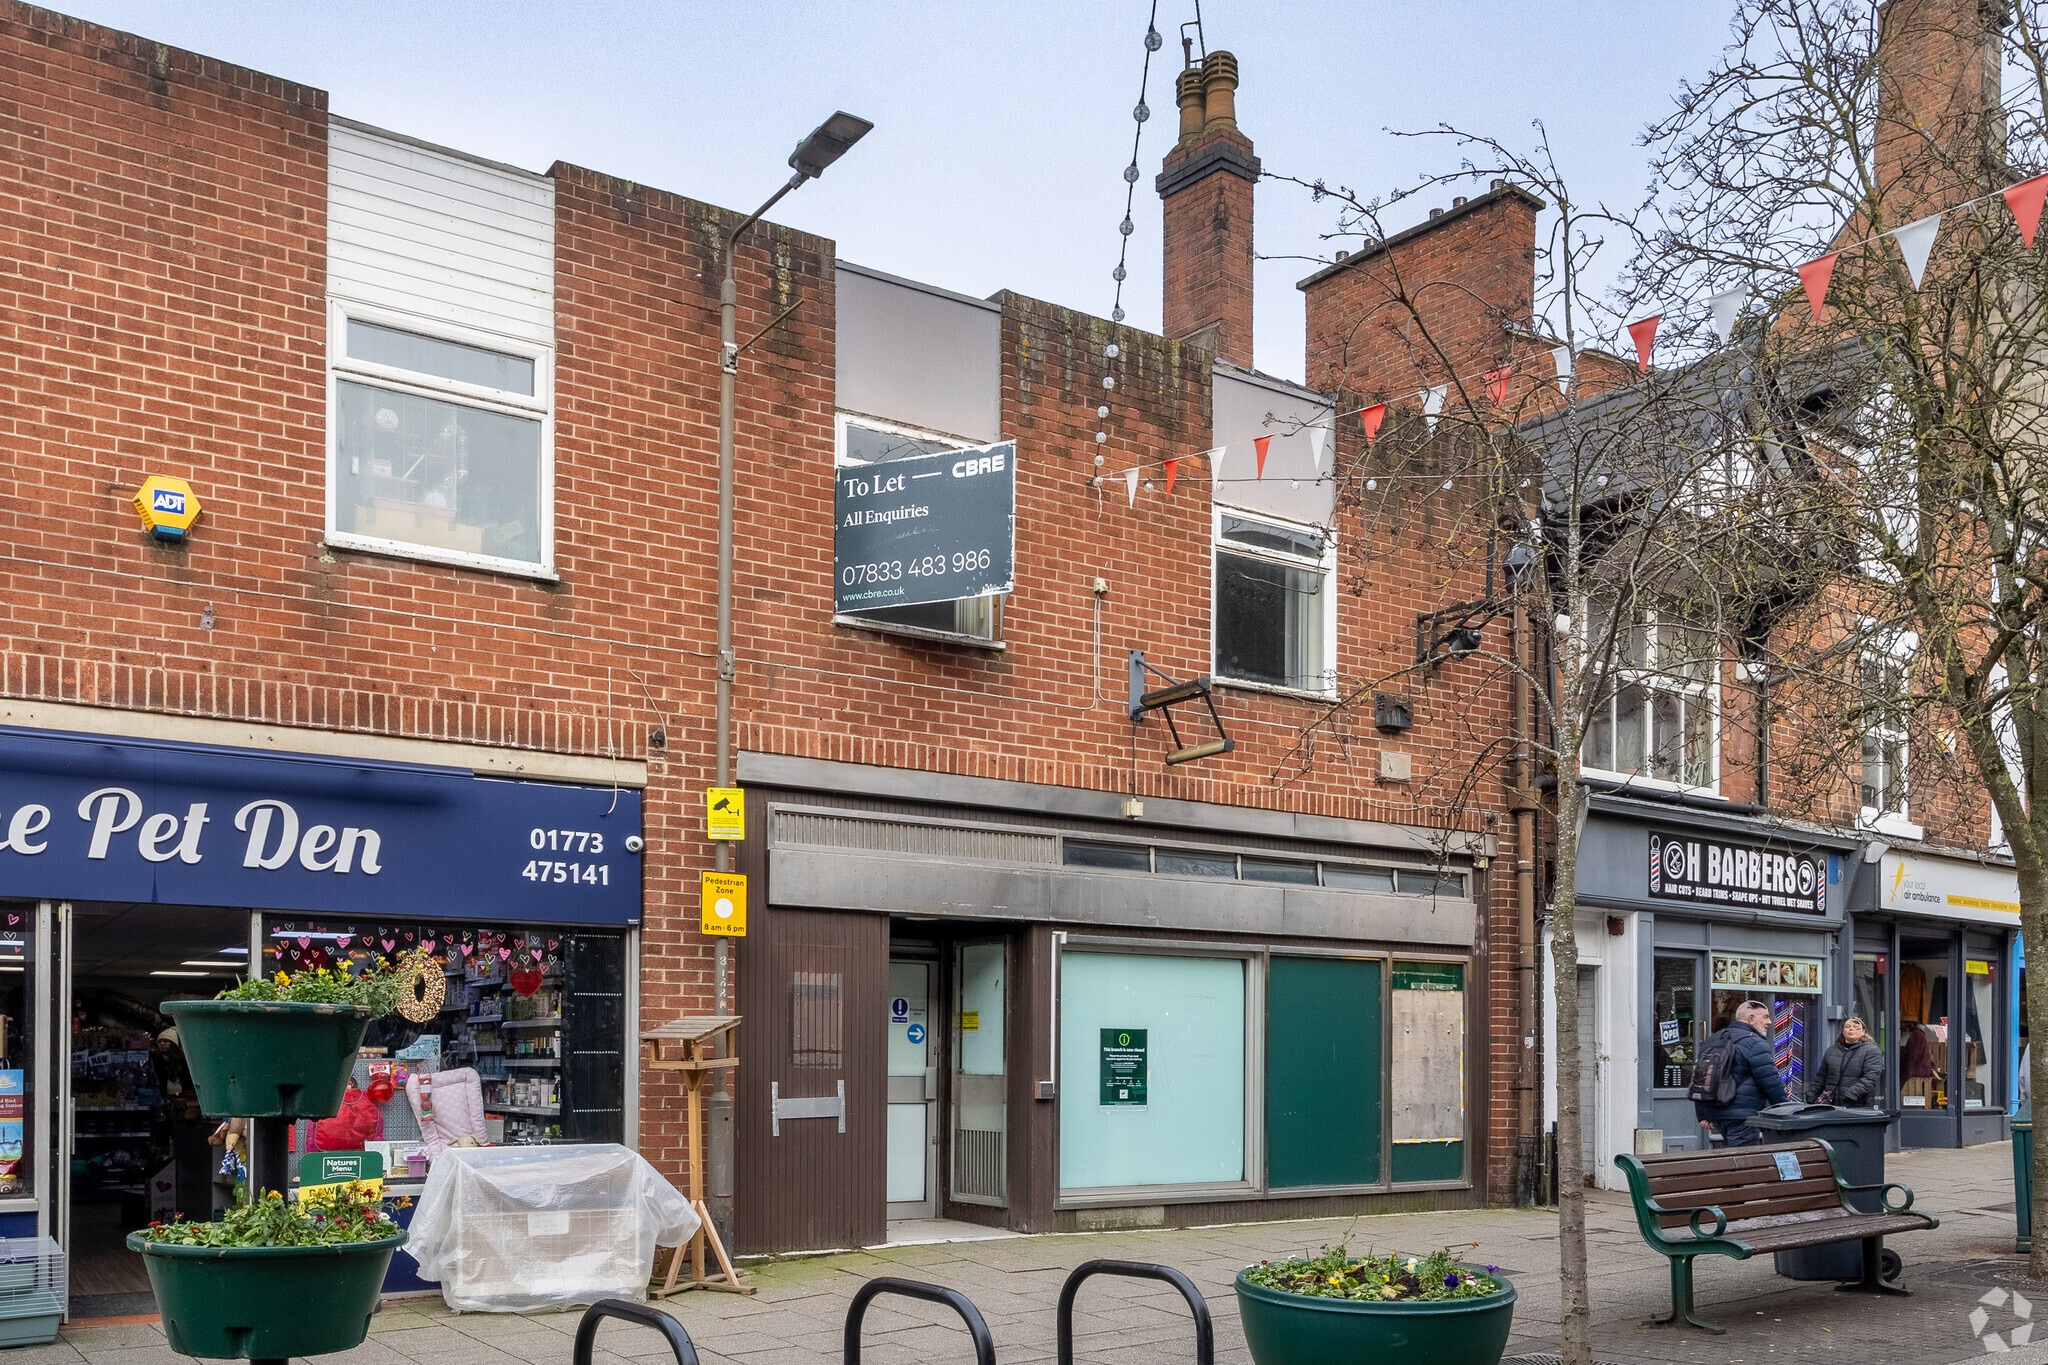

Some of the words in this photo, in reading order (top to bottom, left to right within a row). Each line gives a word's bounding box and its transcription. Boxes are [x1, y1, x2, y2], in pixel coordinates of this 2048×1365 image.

[952, 454, 1004, 478] CBRE
[843, 478, 869, 498] To
[873, 473, 906, 495] Let
[154, 493, 185, 511] ADT
[843, 511, 863, 528] All
[865, 504, 929, 525] Enquiries
[842, 559, 902, 586] 07833
[907, 554, 946, 578] 483
[952, 548, 991, 573] 986
[842, 587, 905, 601] www.cbre.co.uk
[0, 803, 51, 855] e
[77, 786, 211, 865] Pet
[234, 799, 383, 875] Den
[530, 828, 604, 854] 01773
[522, 860, 609, 886] 475141
[705, 876, 745, 887] Pedestrian
[1708, 845, 1797, 894] BARBERS
[715, 886, 734, 895] Zone
[1664, 883, 1678, 894] HAIR
[1678, 884, 1692, 896] CUTS
[1695, 886, 1712, 898] BEARD
[1712, 888, 1729, 900] TRIMS
[1732, 890, 1748, 903] SHAPE
[1748, 892, 1759, 904] UPS
[1761, 894, 1771, 905] HOT
[1771, 895, 1787, 907] TOWEL
[1786, 897, 1797, 908] WET
[1796, 898, 1814, 910] SHAVES
[1904, 890, 1912, 900] air
[1912, 891, 1941, 904] ambulance
[704, 923, 709, 931] 8
[727, 924, 732, 932] 6
[326, 1159, 357, 1167] Natures
